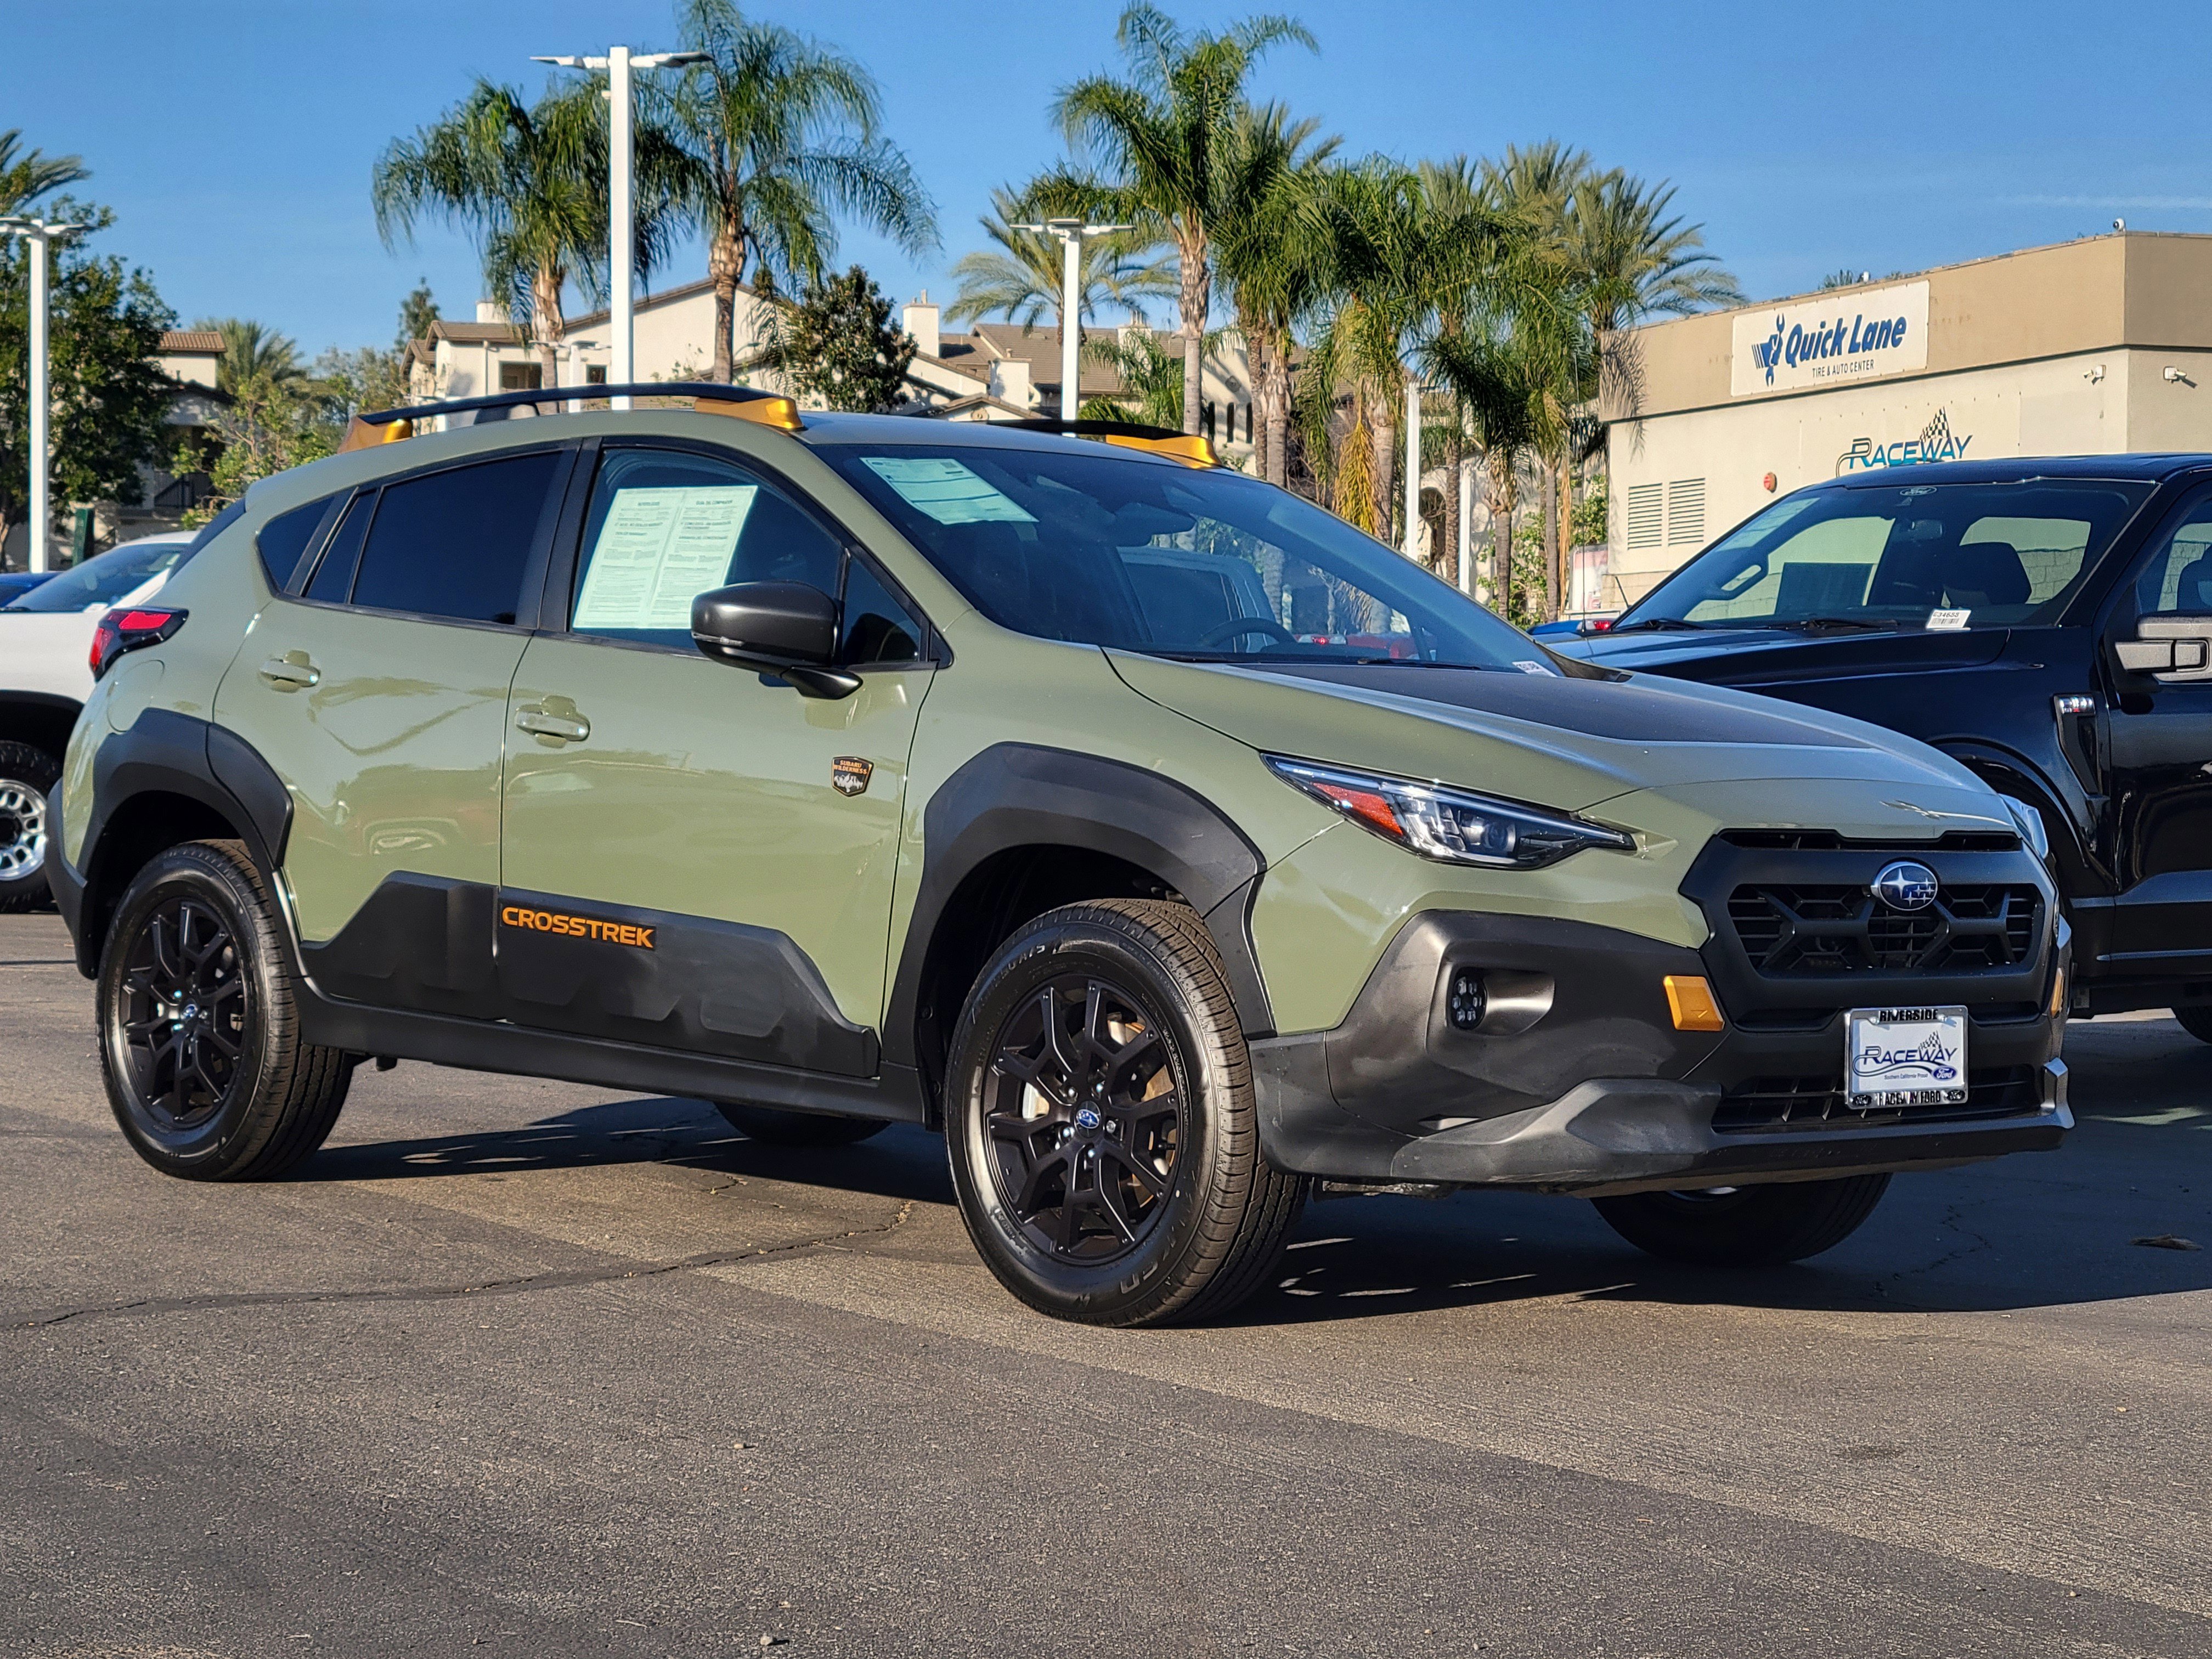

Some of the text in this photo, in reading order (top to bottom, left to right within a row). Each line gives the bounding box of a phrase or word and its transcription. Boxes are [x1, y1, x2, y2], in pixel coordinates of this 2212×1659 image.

[1785, 314, 1907, 368] Quick Lane
[1812, 359, 1875, 379] TIRE & AUTO CENTER
[1849, 434, 1973, 470] RACEWAY
[833, 764, 867, 775] WILDERNESS
[839, 760, 862, 768] SUBARU
[501, 906, 655, 949] CROSSTREK
[1878, 1009, 1939, 1022] RIVERSIDE
[1863, 1046, 1958, 1065] RACEWAY
[1936, 1068, 1954, 1079] Ford
[1919, 1090, 1941, 1104] FORD
